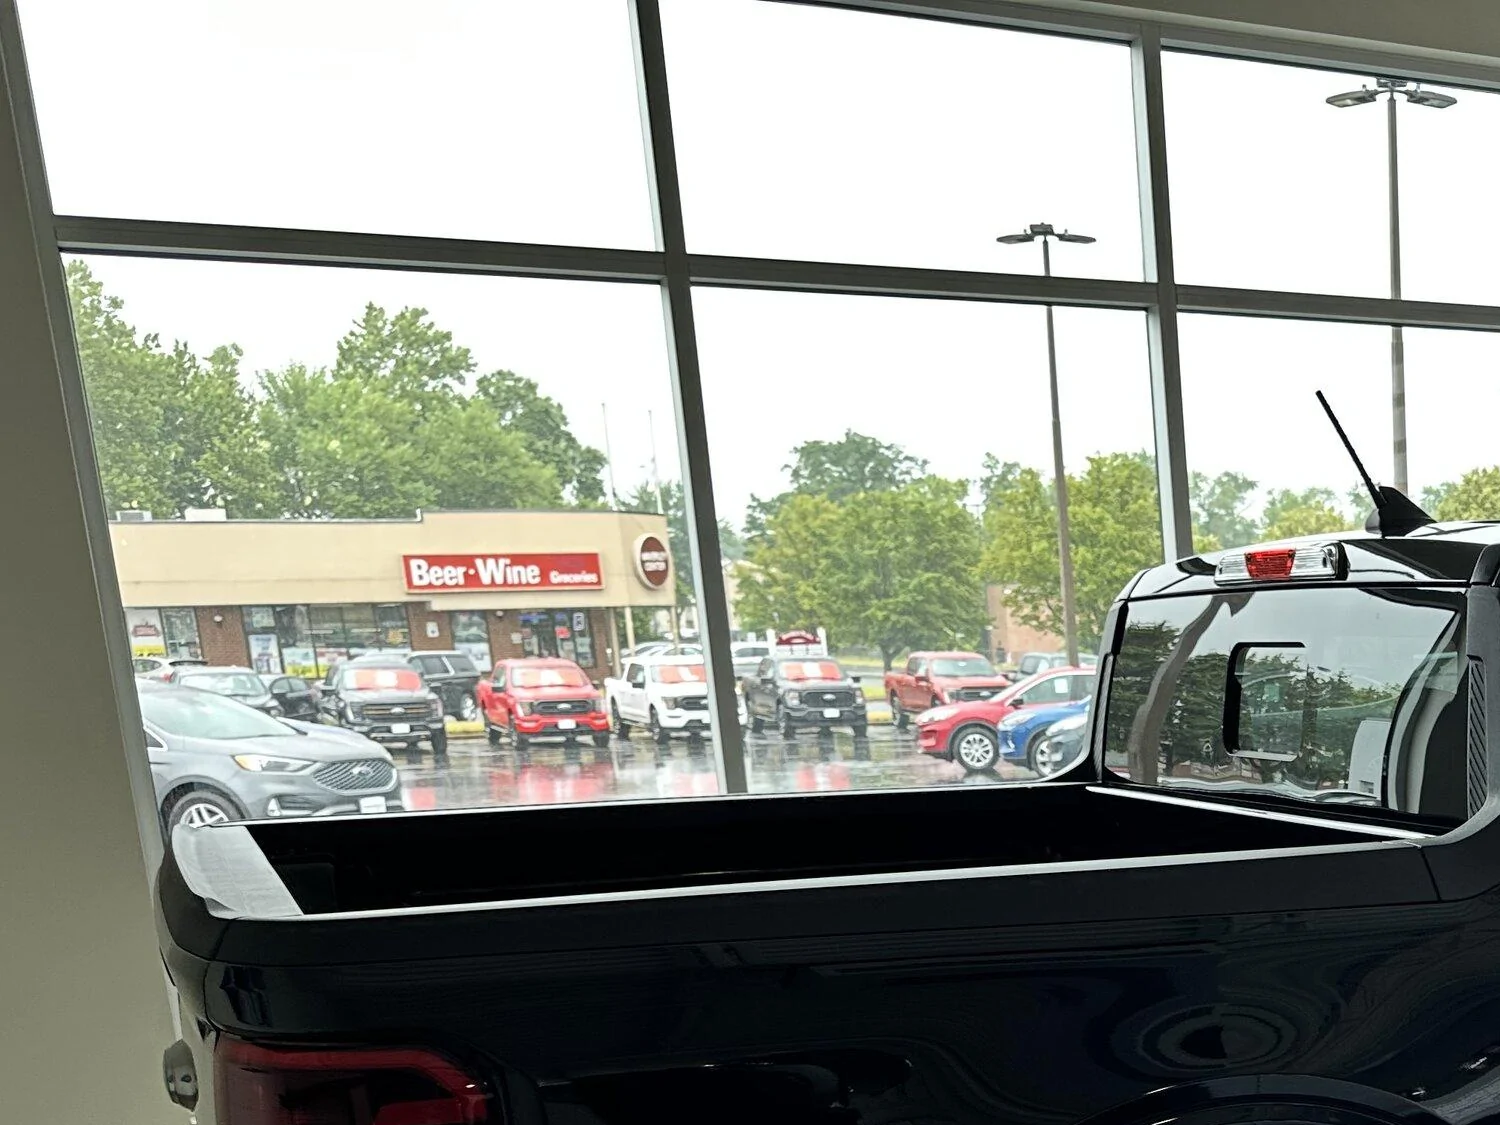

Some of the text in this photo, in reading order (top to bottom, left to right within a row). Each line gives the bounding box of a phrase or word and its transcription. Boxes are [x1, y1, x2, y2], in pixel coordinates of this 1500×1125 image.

[409, 557, 599, 587] Beer Wine Groceries
